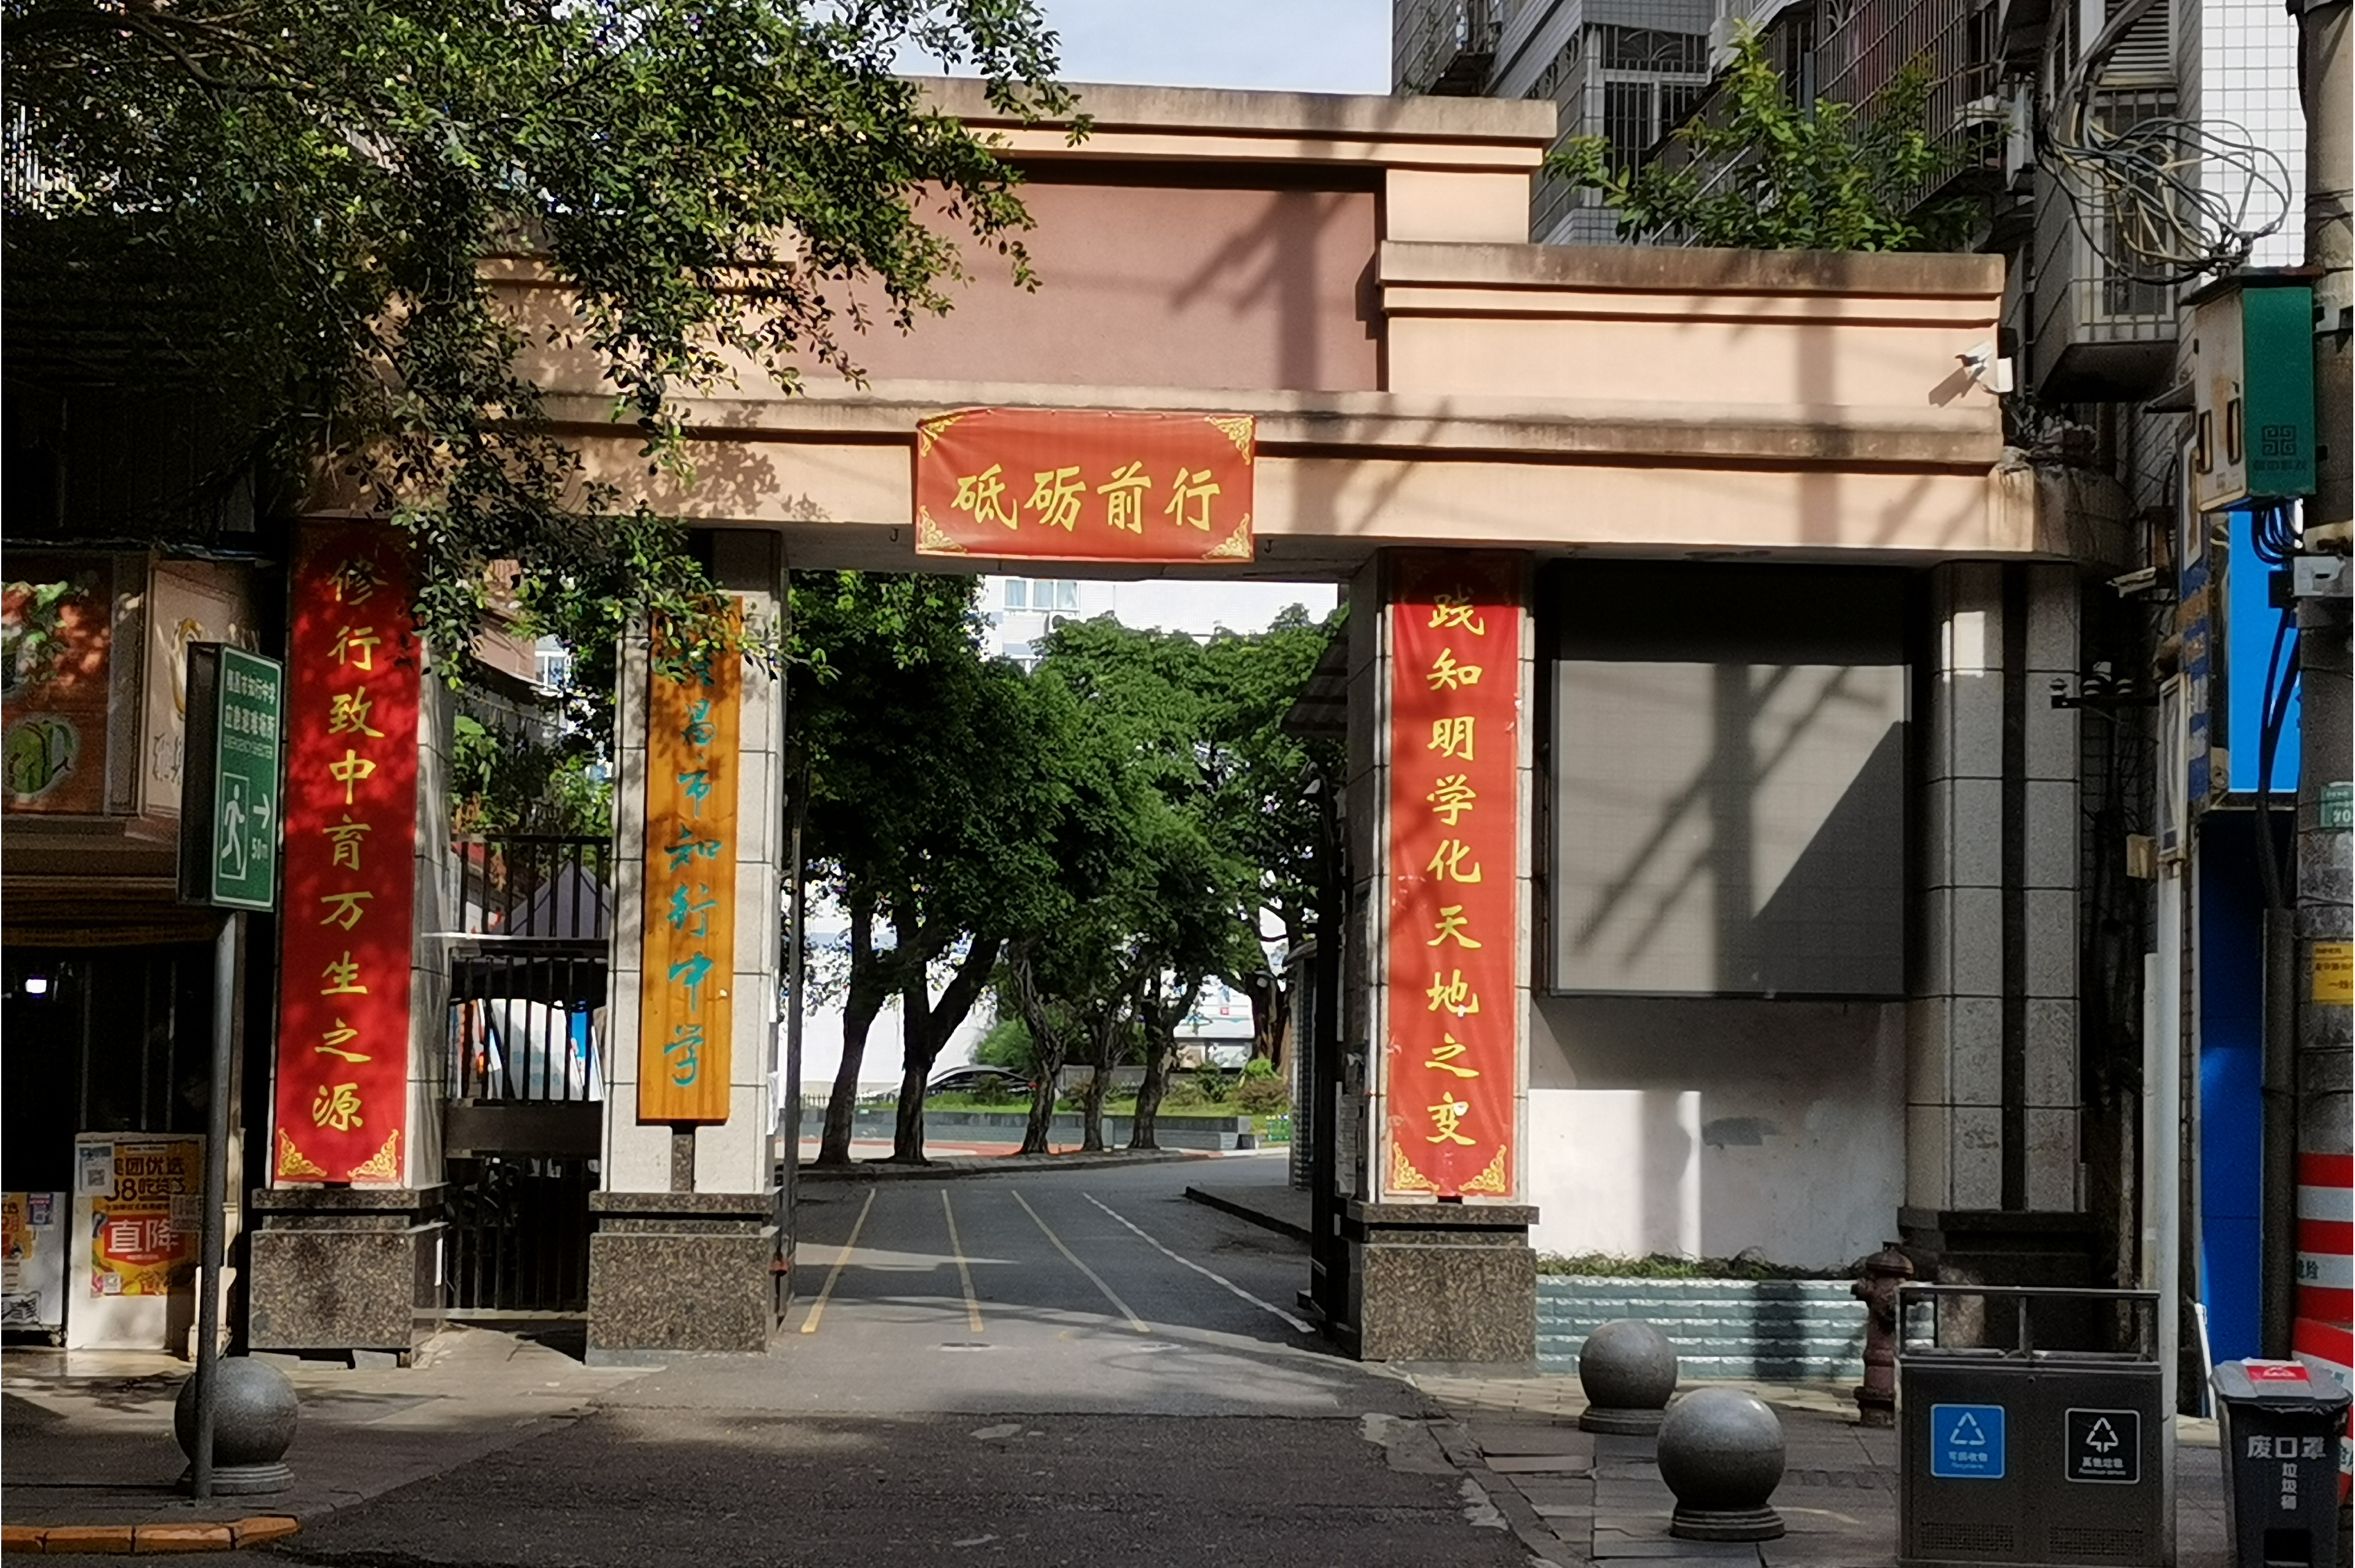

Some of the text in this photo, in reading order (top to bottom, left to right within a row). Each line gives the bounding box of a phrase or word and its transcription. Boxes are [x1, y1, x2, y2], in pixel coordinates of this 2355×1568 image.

[951, 460, 1221, 534] 砥砺前行
[312, 560, 388, 1131] 修行致中育万生之源
[1425, 584, 1485, 1146] 践知明学化天地之变
[108, 1219, 179, 1253] 直降
[2247, 1435, 2327, 1460] 废口罩
